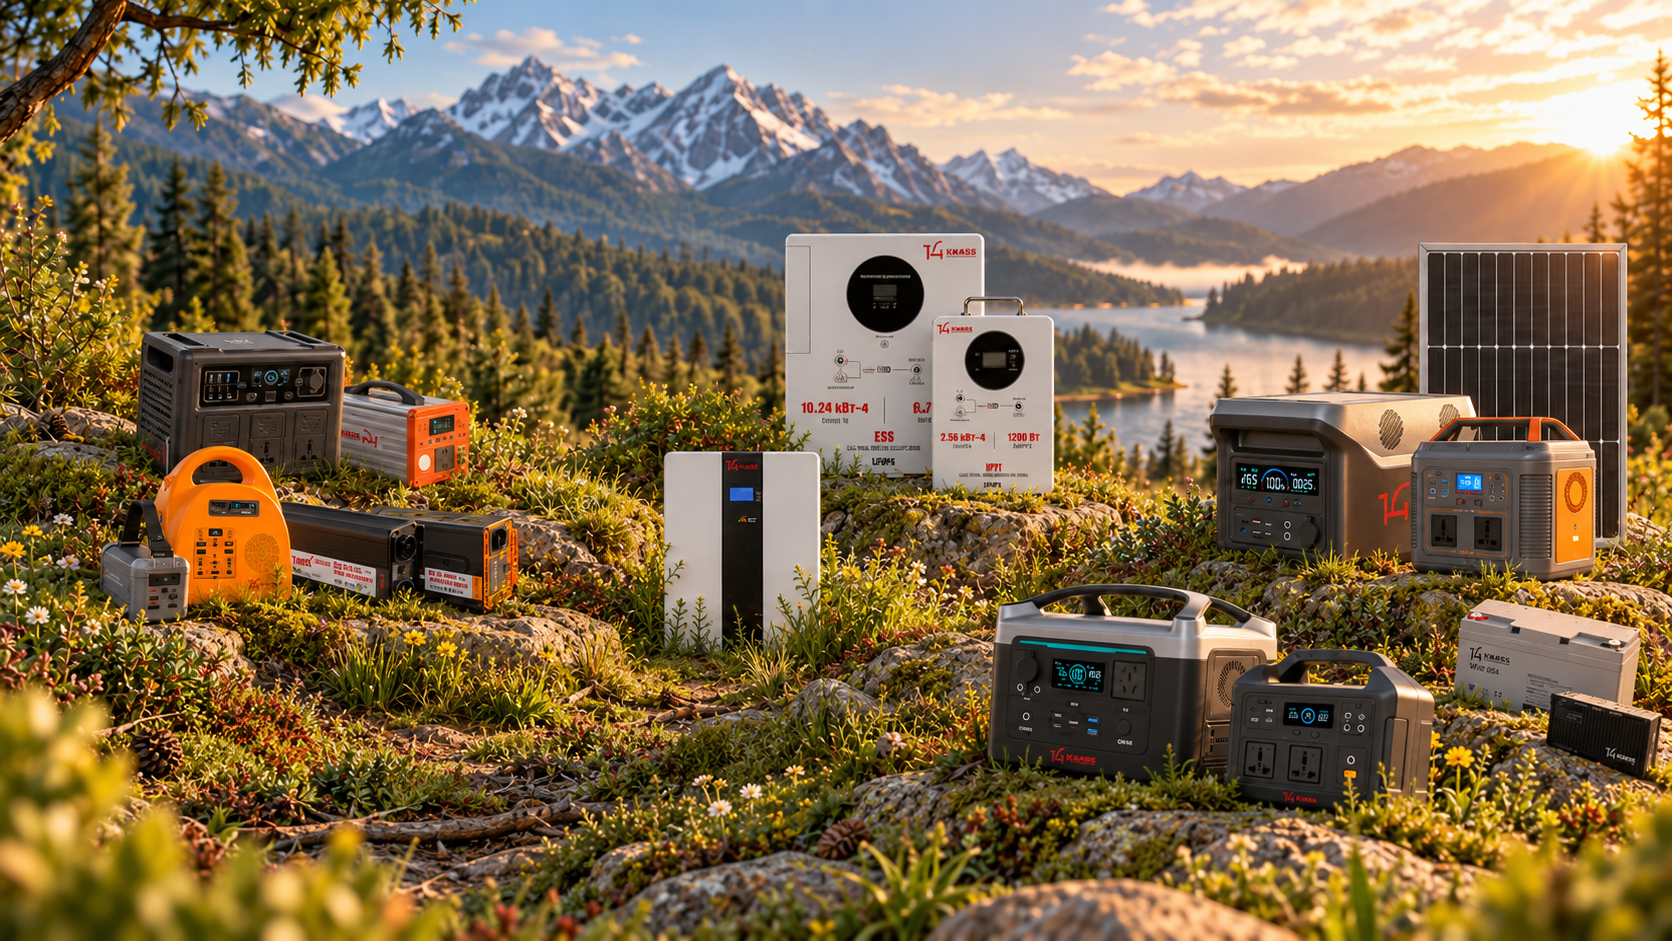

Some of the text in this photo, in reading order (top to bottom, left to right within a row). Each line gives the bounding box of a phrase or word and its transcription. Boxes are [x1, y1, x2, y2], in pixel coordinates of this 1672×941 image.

[801, 402, 832, 414] 10.24
[874, 430, 895, 443] ESS
[1007, 432, 1028, 442] 1200
